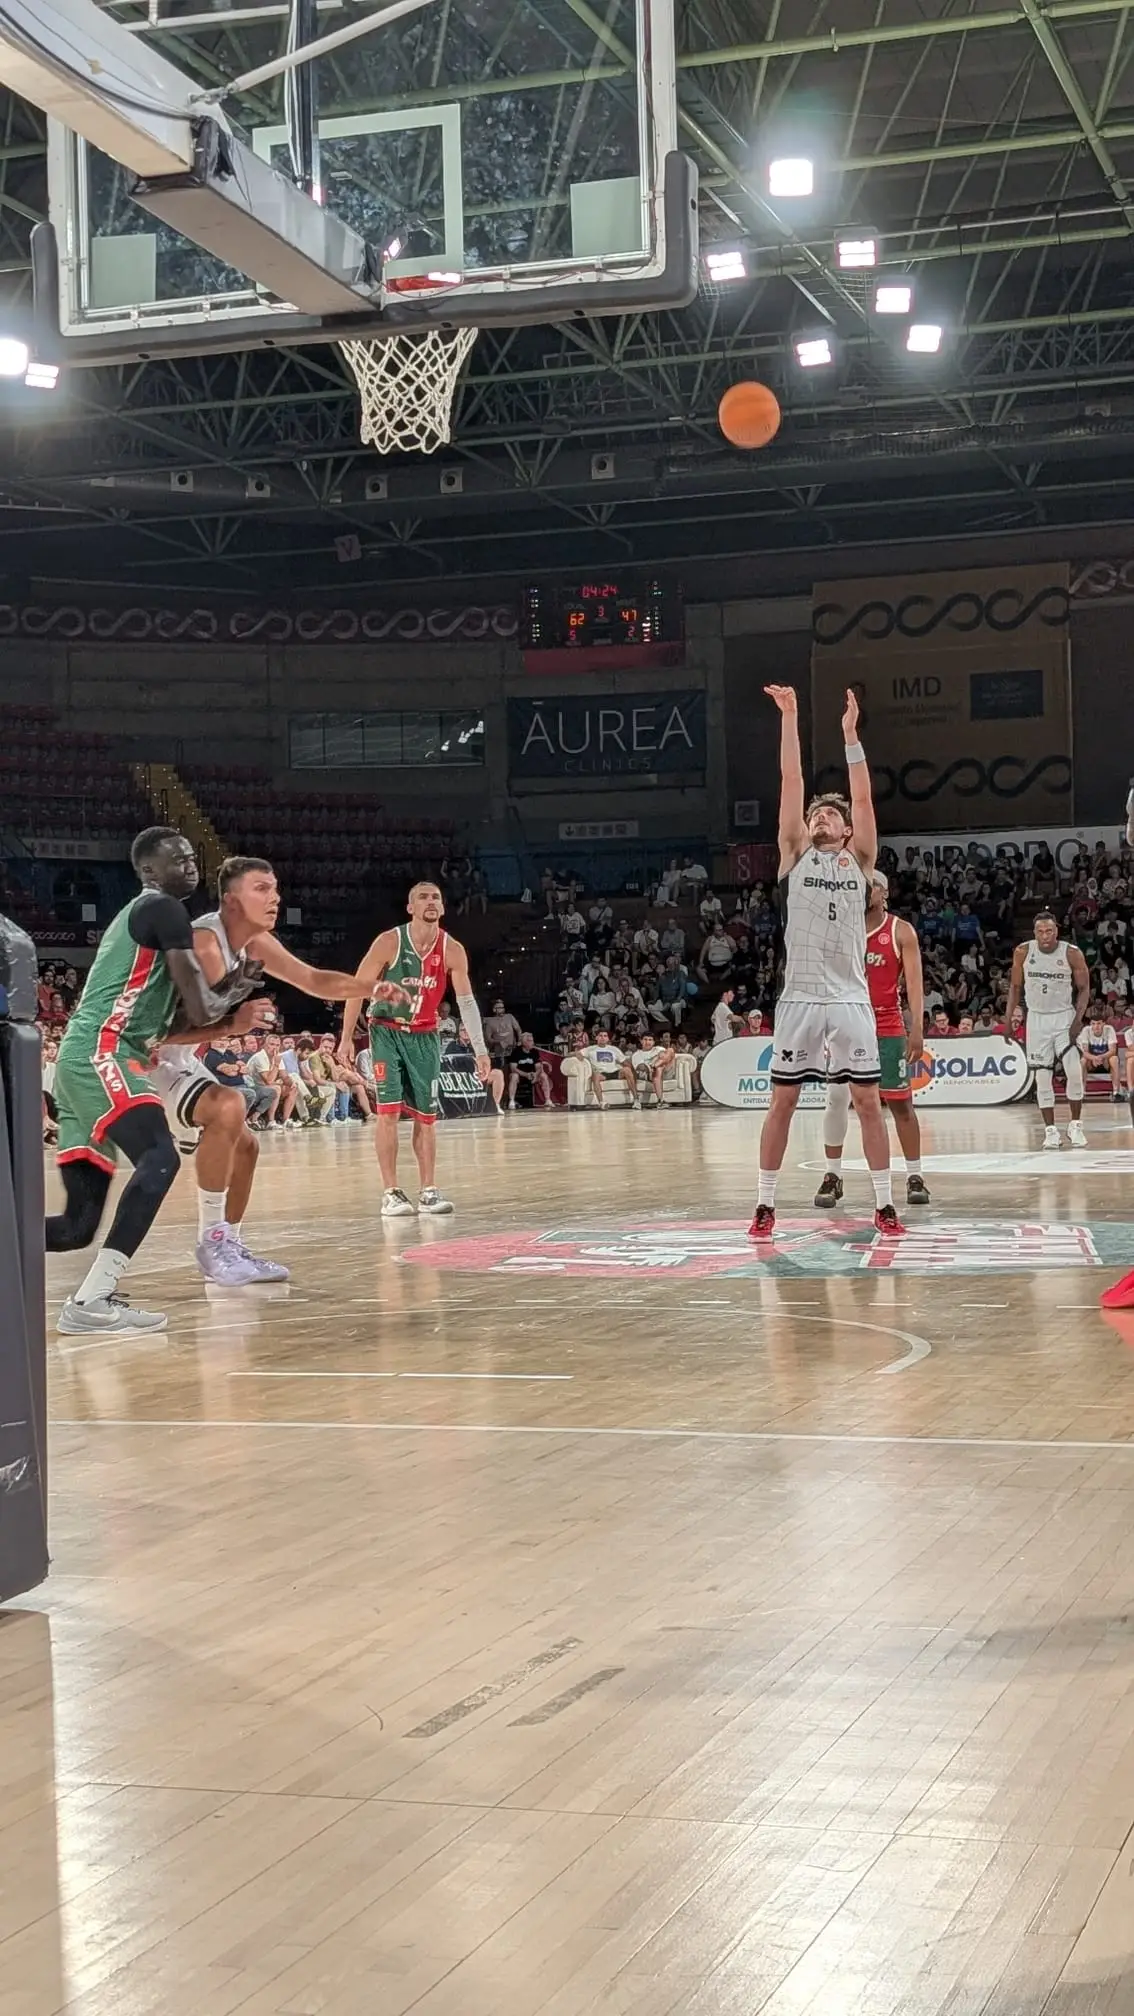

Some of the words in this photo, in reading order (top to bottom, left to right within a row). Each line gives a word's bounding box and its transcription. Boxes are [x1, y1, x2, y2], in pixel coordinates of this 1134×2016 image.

[581, 584, 618, 598] 04:24
[569, 612, 585, 625] 62
[892, 676, 941, 699] IMD
[563, 758, 650, 773] CLINICS
[828, 902, 837, 921] 5
